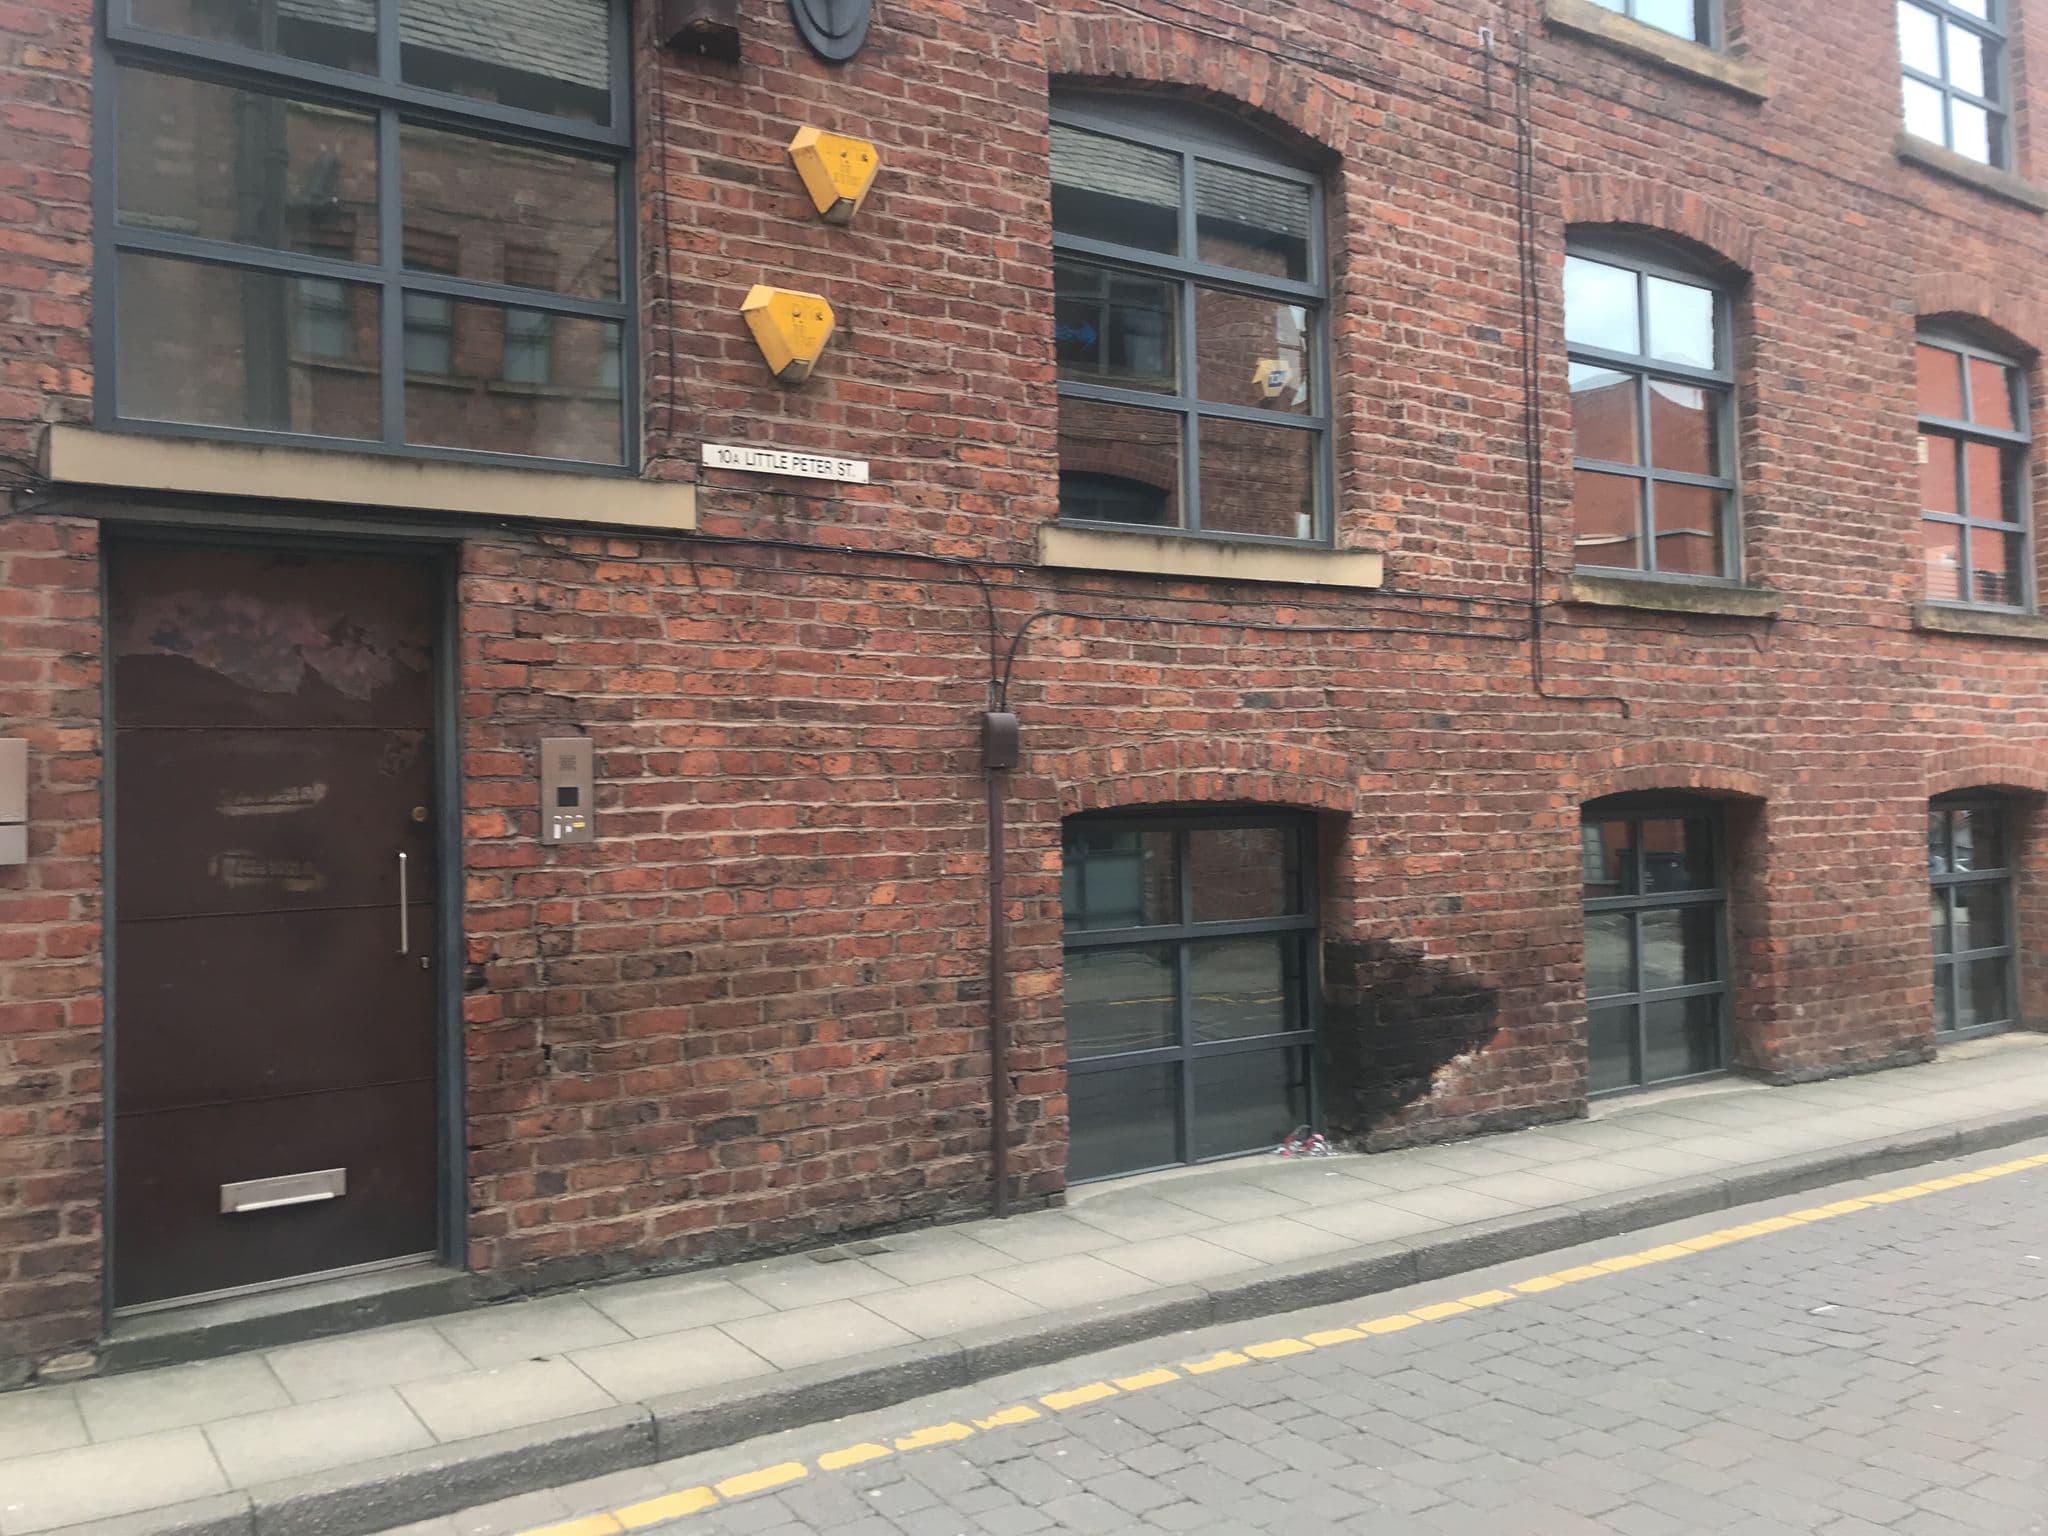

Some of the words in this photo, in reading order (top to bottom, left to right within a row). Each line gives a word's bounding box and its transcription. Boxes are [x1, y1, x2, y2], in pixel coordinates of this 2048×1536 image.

[718, 449, 738, 464] 10A
[745, 453, 787, 469] LITTLE
[792, 457, 833, 474] PETER
